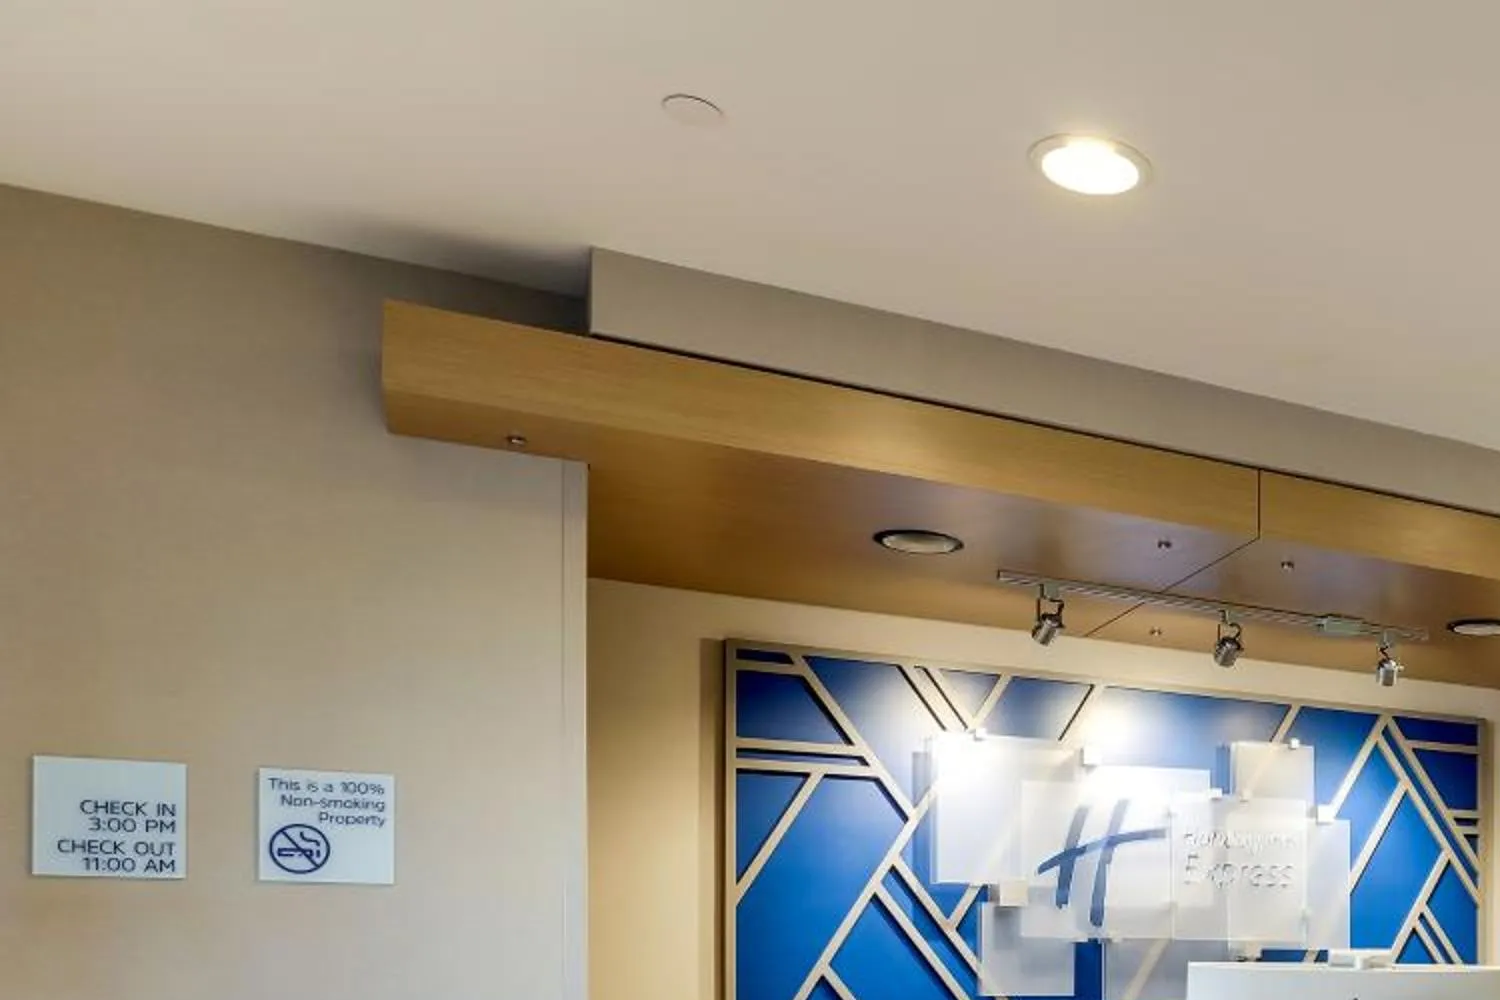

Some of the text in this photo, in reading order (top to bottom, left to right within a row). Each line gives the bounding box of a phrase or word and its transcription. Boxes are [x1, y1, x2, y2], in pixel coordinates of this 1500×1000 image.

[268, 777, 385, 795] This is a 100%
[80, 799, 176, 817] CHECK IN
[280, 794, 385, 813] Non-smoking
[88, 817, 176, 833] 3:00 PM
[319, 810, 385, 828] Property
[57, 839, 176, 857] CHECK OUT
[81, 857, 176, 873] 11:00 AM
